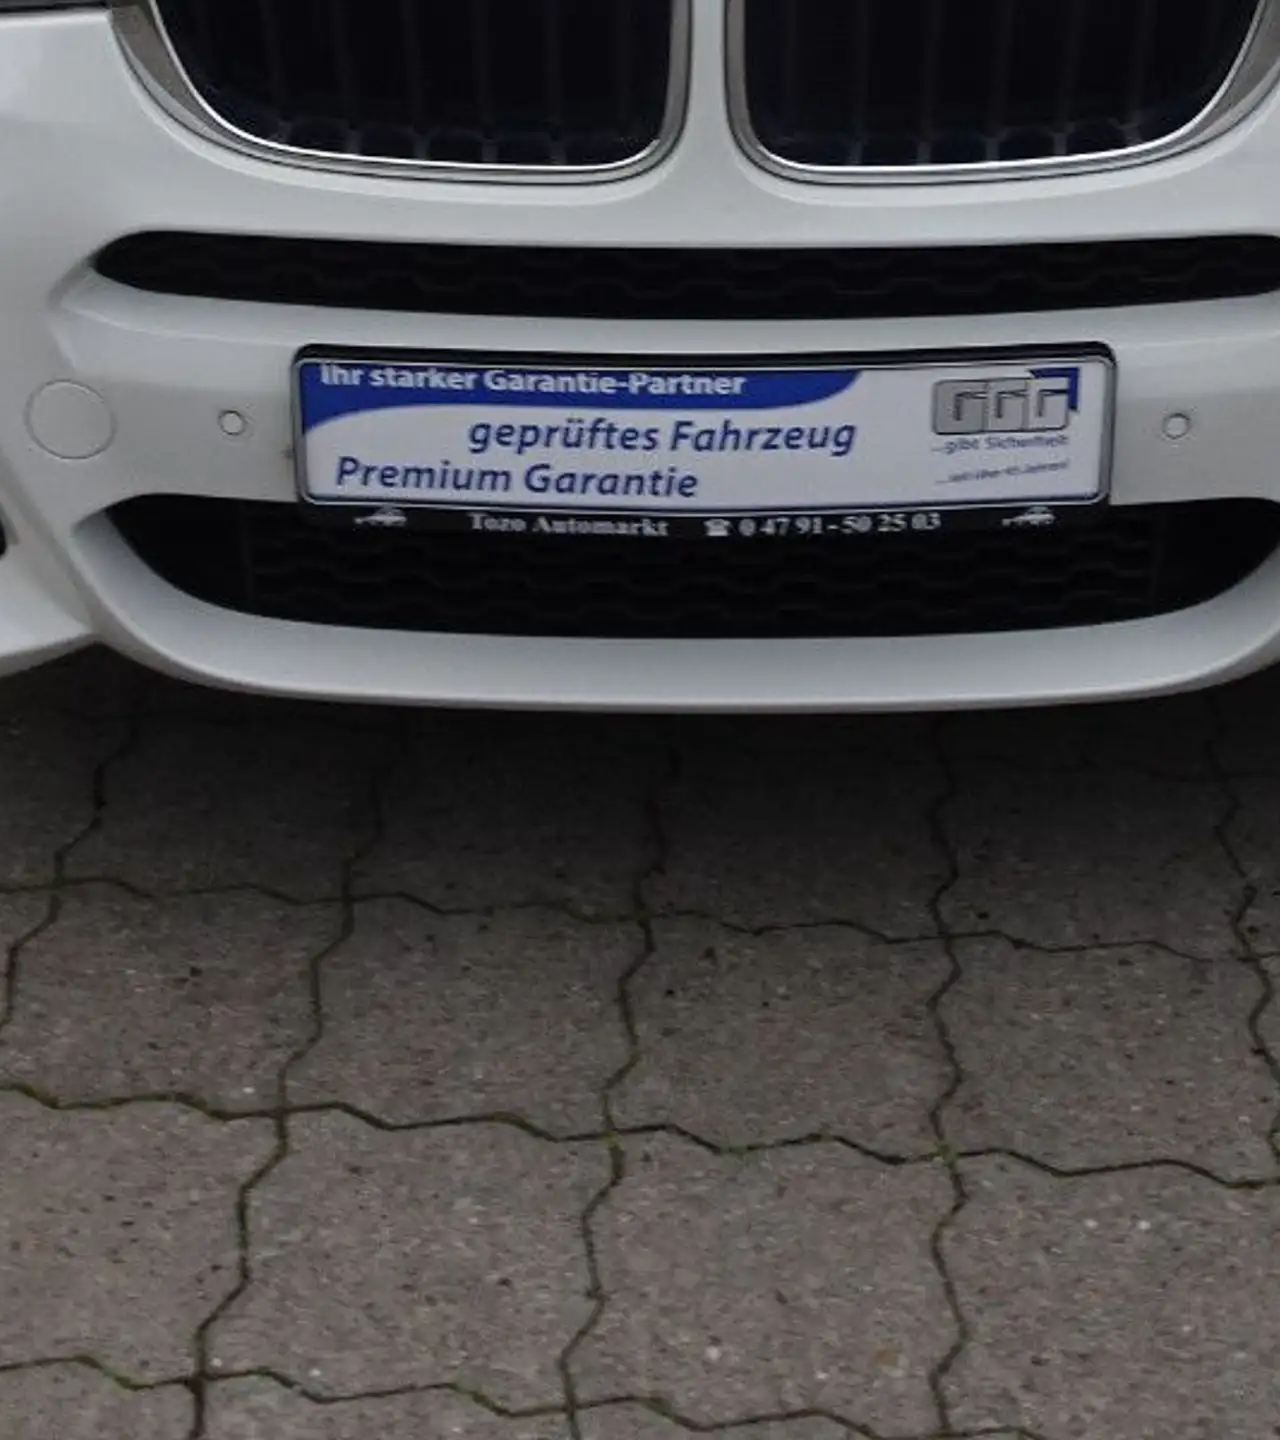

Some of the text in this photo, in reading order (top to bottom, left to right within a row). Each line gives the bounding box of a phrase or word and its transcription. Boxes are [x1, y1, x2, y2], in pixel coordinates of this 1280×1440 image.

[322, 363, 748, 396] Ihr starker Garantie-Partner
[469, 417, 857, 457] geprüftes Fahrzeug
[336, 456, 698, 498] Premium Garantie
[532, 515, 669, 536] Automarkt
